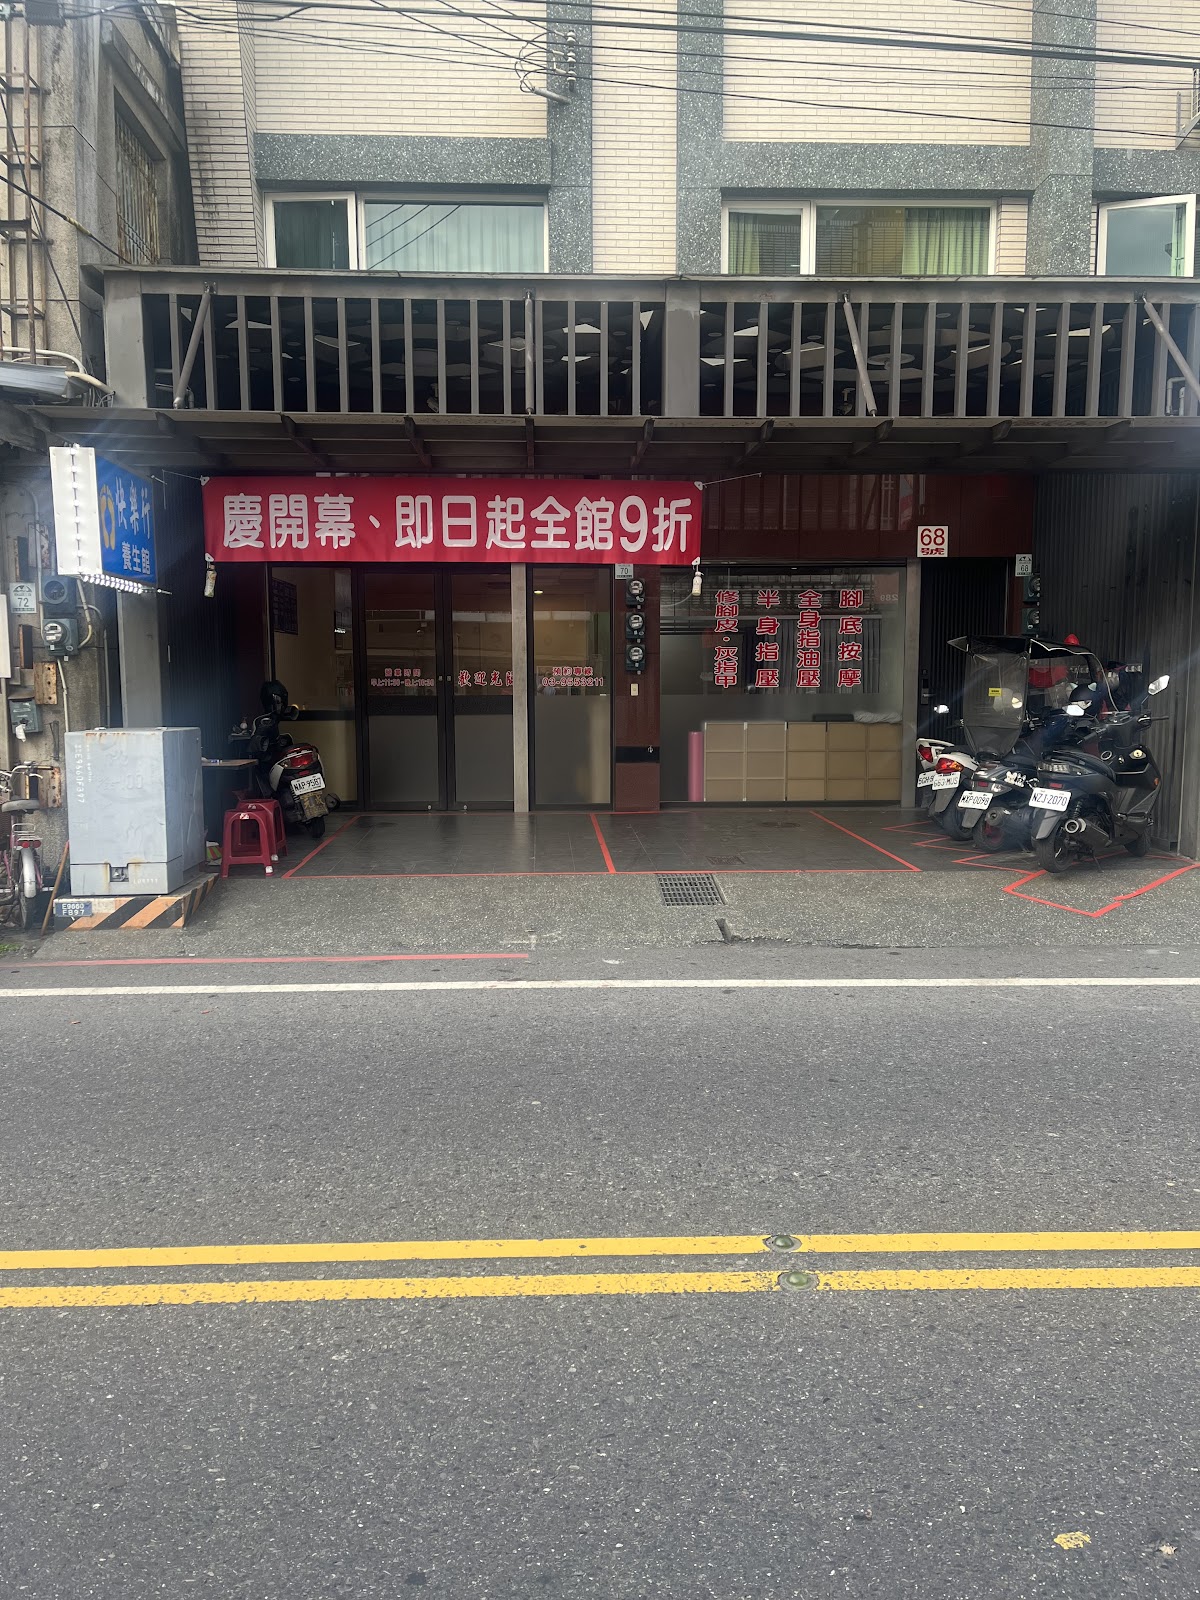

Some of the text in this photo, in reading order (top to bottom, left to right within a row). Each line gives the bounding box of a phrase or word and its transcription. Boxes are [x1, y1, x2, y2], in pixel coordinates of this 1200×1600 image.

[223, 493, 692, 553] 慶開幕、即日起全館9折
[920, 528, 945, 546] 68
[121, 541, 151, 575] 養生館
[620, 567, 629, 575] 70
[17, 597, 29, 607] 72
[755, 590, 780, 687] 半身指壓
[796, 589, 822, 687] 全身指油壓
[838, 589, 863, 687] 腳底按摩
[1031, 792, 1068, 807] NZJ-2070
